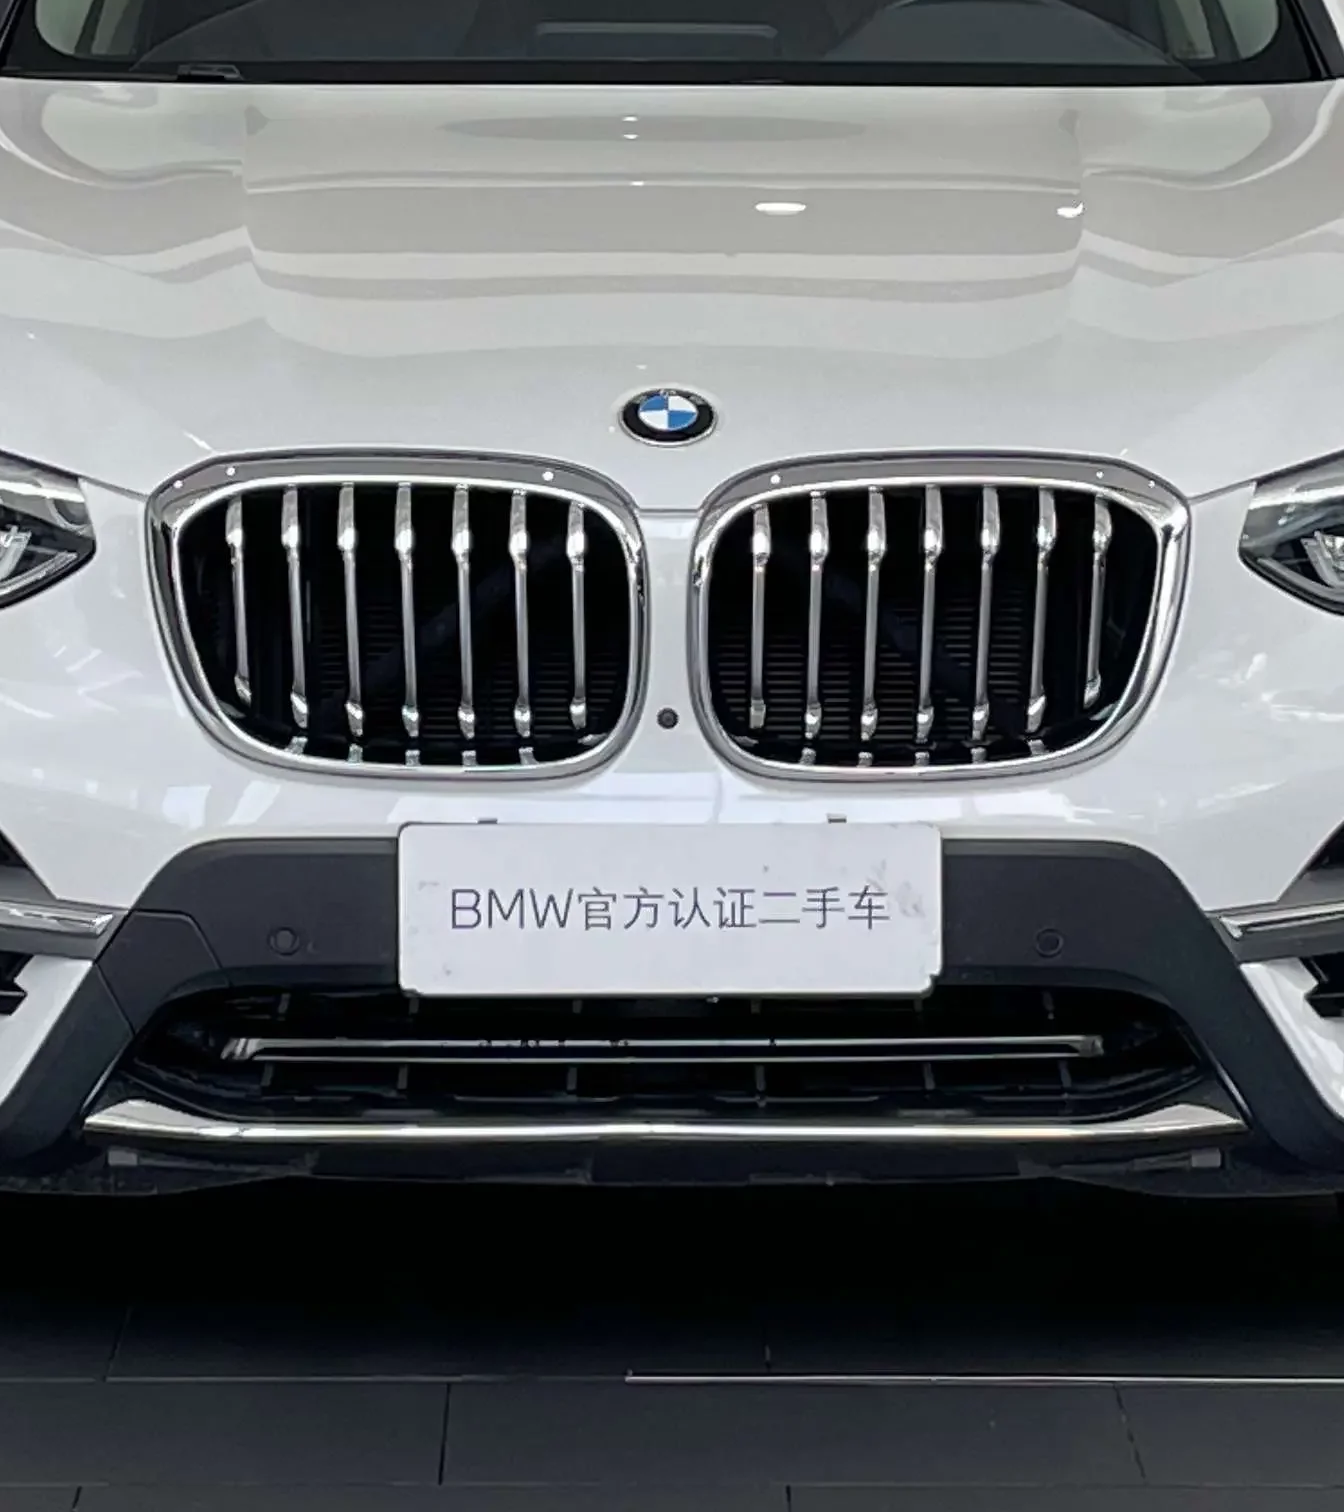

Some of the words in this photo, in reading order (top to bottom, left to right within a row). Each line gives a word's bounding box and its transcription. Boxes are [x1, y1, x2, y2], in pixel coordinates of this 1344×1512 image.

[450, 886, 891, 930] BMW官方认证二手车
